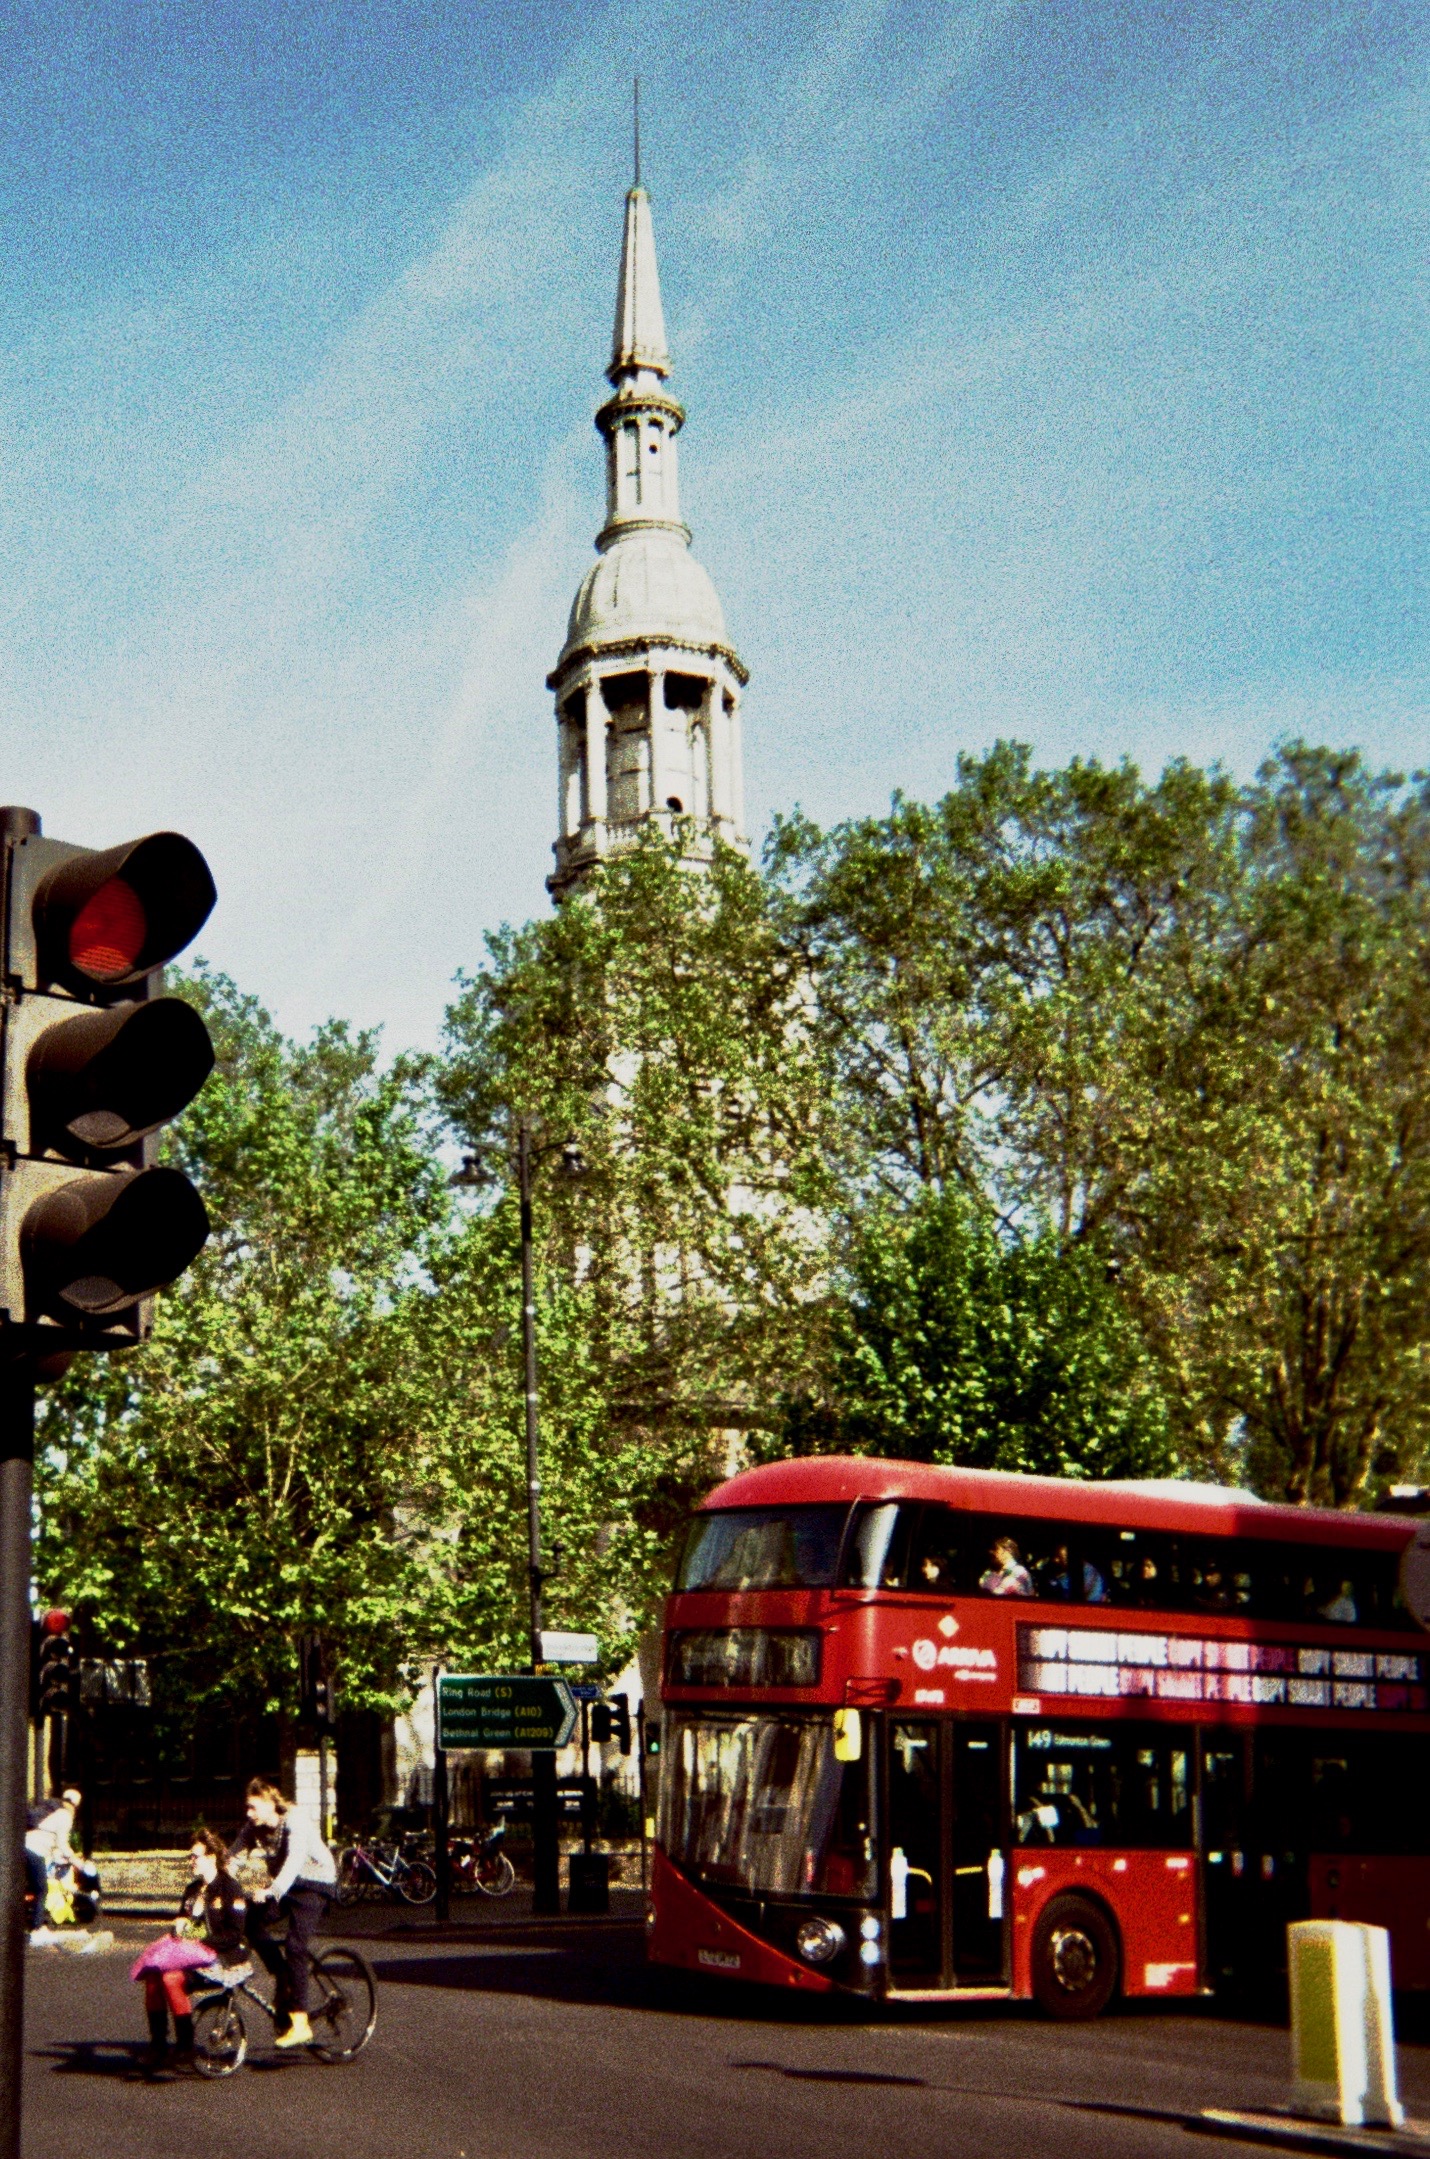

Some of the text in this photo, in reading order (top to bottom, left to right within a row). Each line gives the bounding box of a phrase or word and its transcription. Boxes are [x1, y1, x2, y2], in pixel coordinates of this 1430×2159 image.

[441, 1686, 513, 1699] Ring Road (S)
[442, 1705, 542, 1719] London Bridge (A10)
[442, 1726, 554, 1738] Bethnal Green (A1209)
[1028, 1729, 1051, 1748] 149
